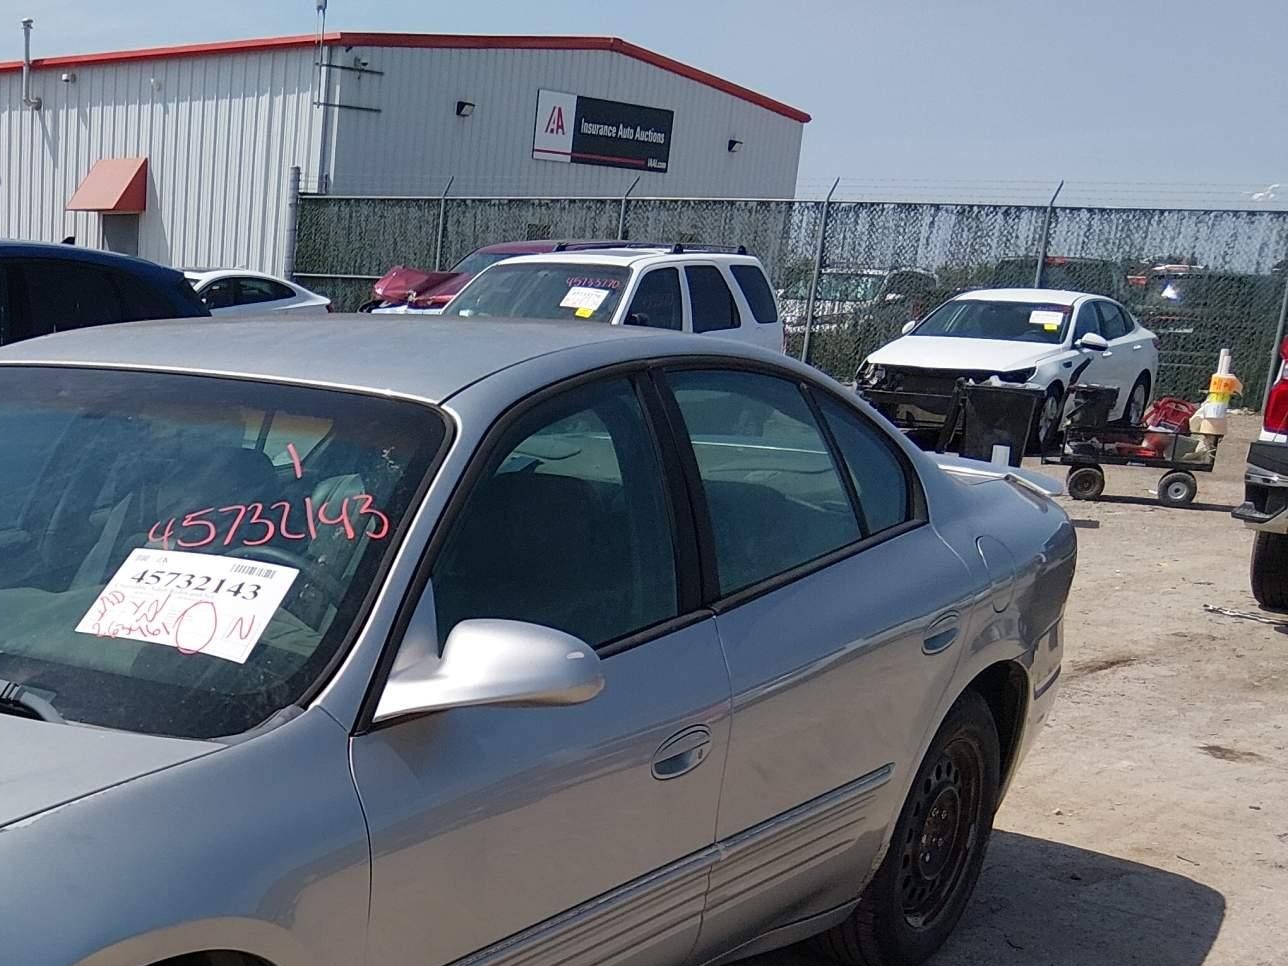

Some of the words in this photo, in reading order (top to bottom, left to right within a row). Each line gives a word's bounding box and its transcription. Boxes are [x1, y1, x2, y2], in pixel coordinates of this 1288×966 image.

[580, 118, 616, 139] Insurance
[617, 123, 634, 140] Auto
[634, 127, 665, 144] Auctions
[148, 494, 390, 550] 45732143
[130, 569, 262, 600] 45732143
